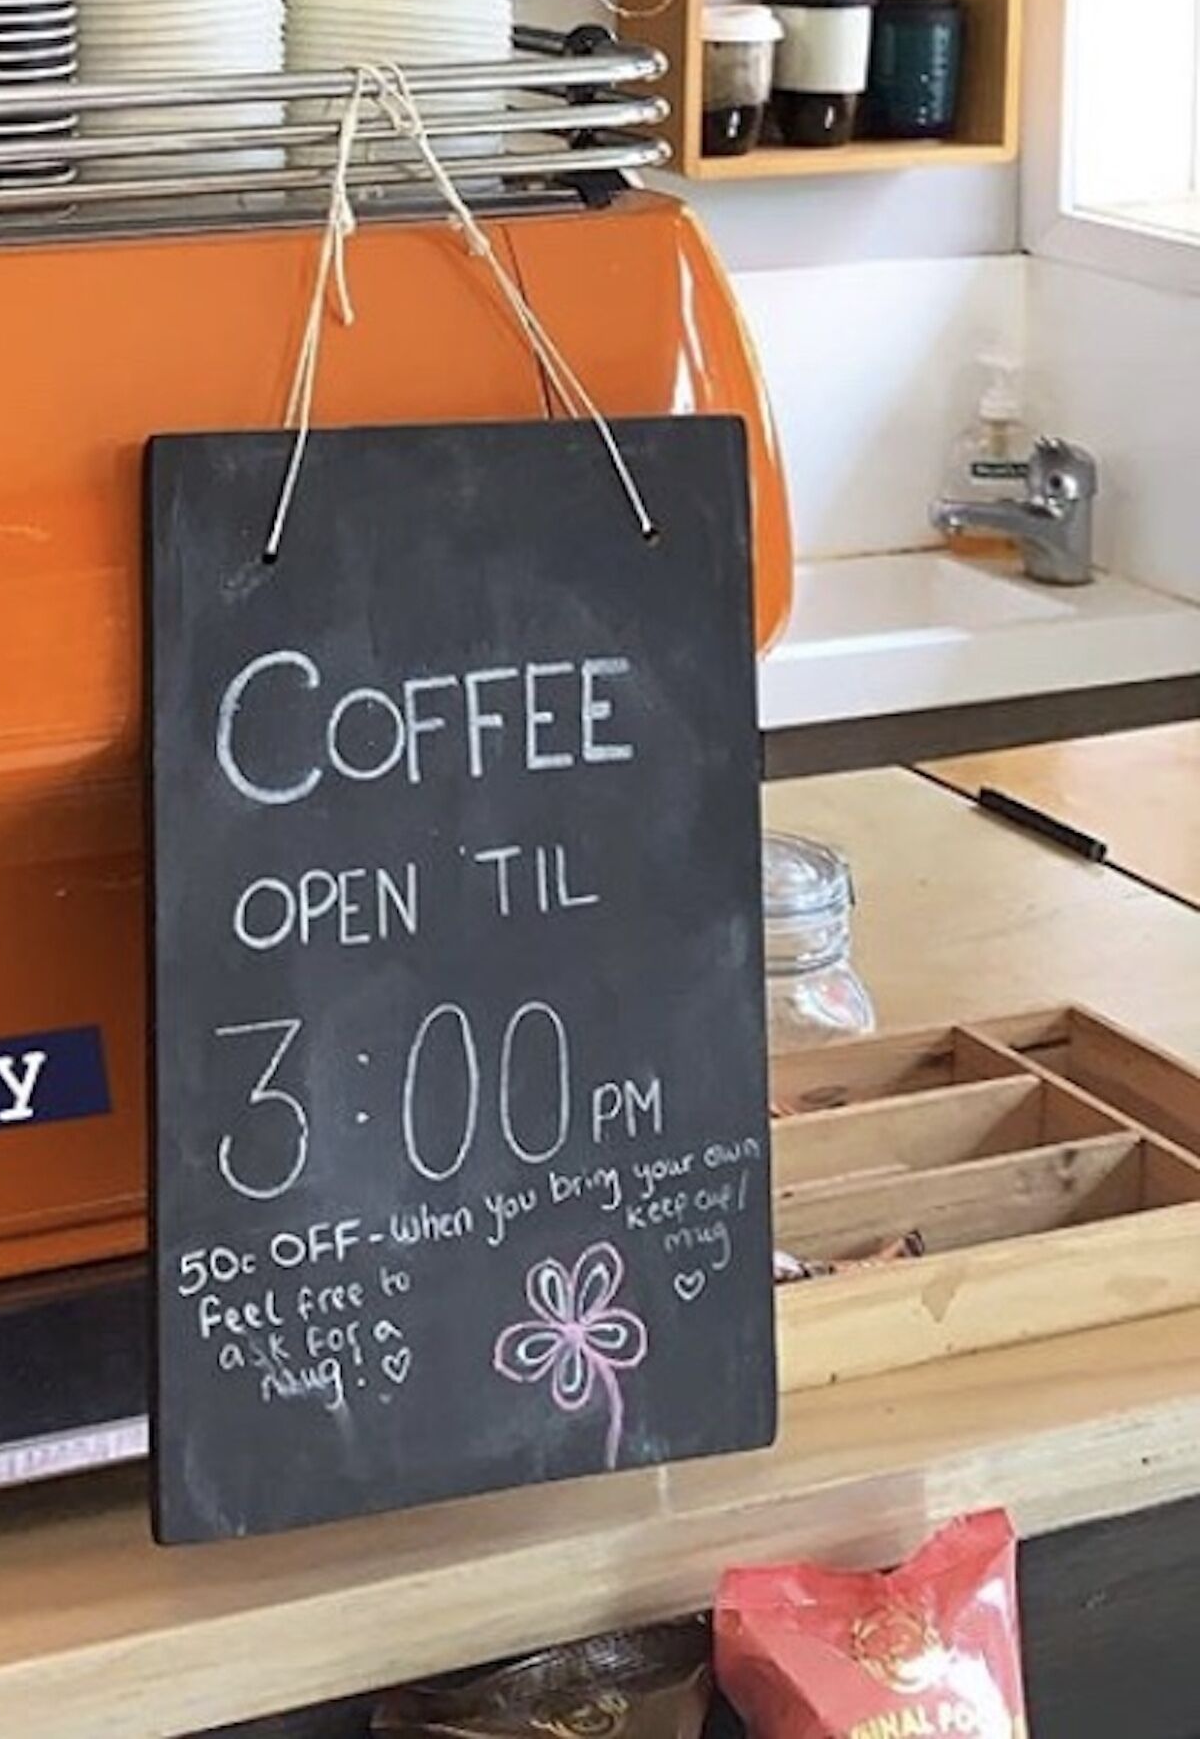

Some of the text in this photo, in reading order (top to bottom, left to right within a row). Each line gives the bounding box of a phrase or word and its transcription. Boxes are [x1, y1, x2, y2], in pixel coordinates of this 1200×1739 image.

[216, 650, 634, 805] COFFEE
[233, 862, 418, 950] OPEN
[215, 1001, 663, 1199] 3:00 PM
[484, 1190, 538, 1248] you
[549, 1166, 623, 1210] bring
[632, 1152, 695, 1199] your
[702, 1137, 762, 1169] own
[378, 1265, 412, 1298] to
[662, 1221, 732, 1271] mug
[373, 1318, 404, 1344] a
